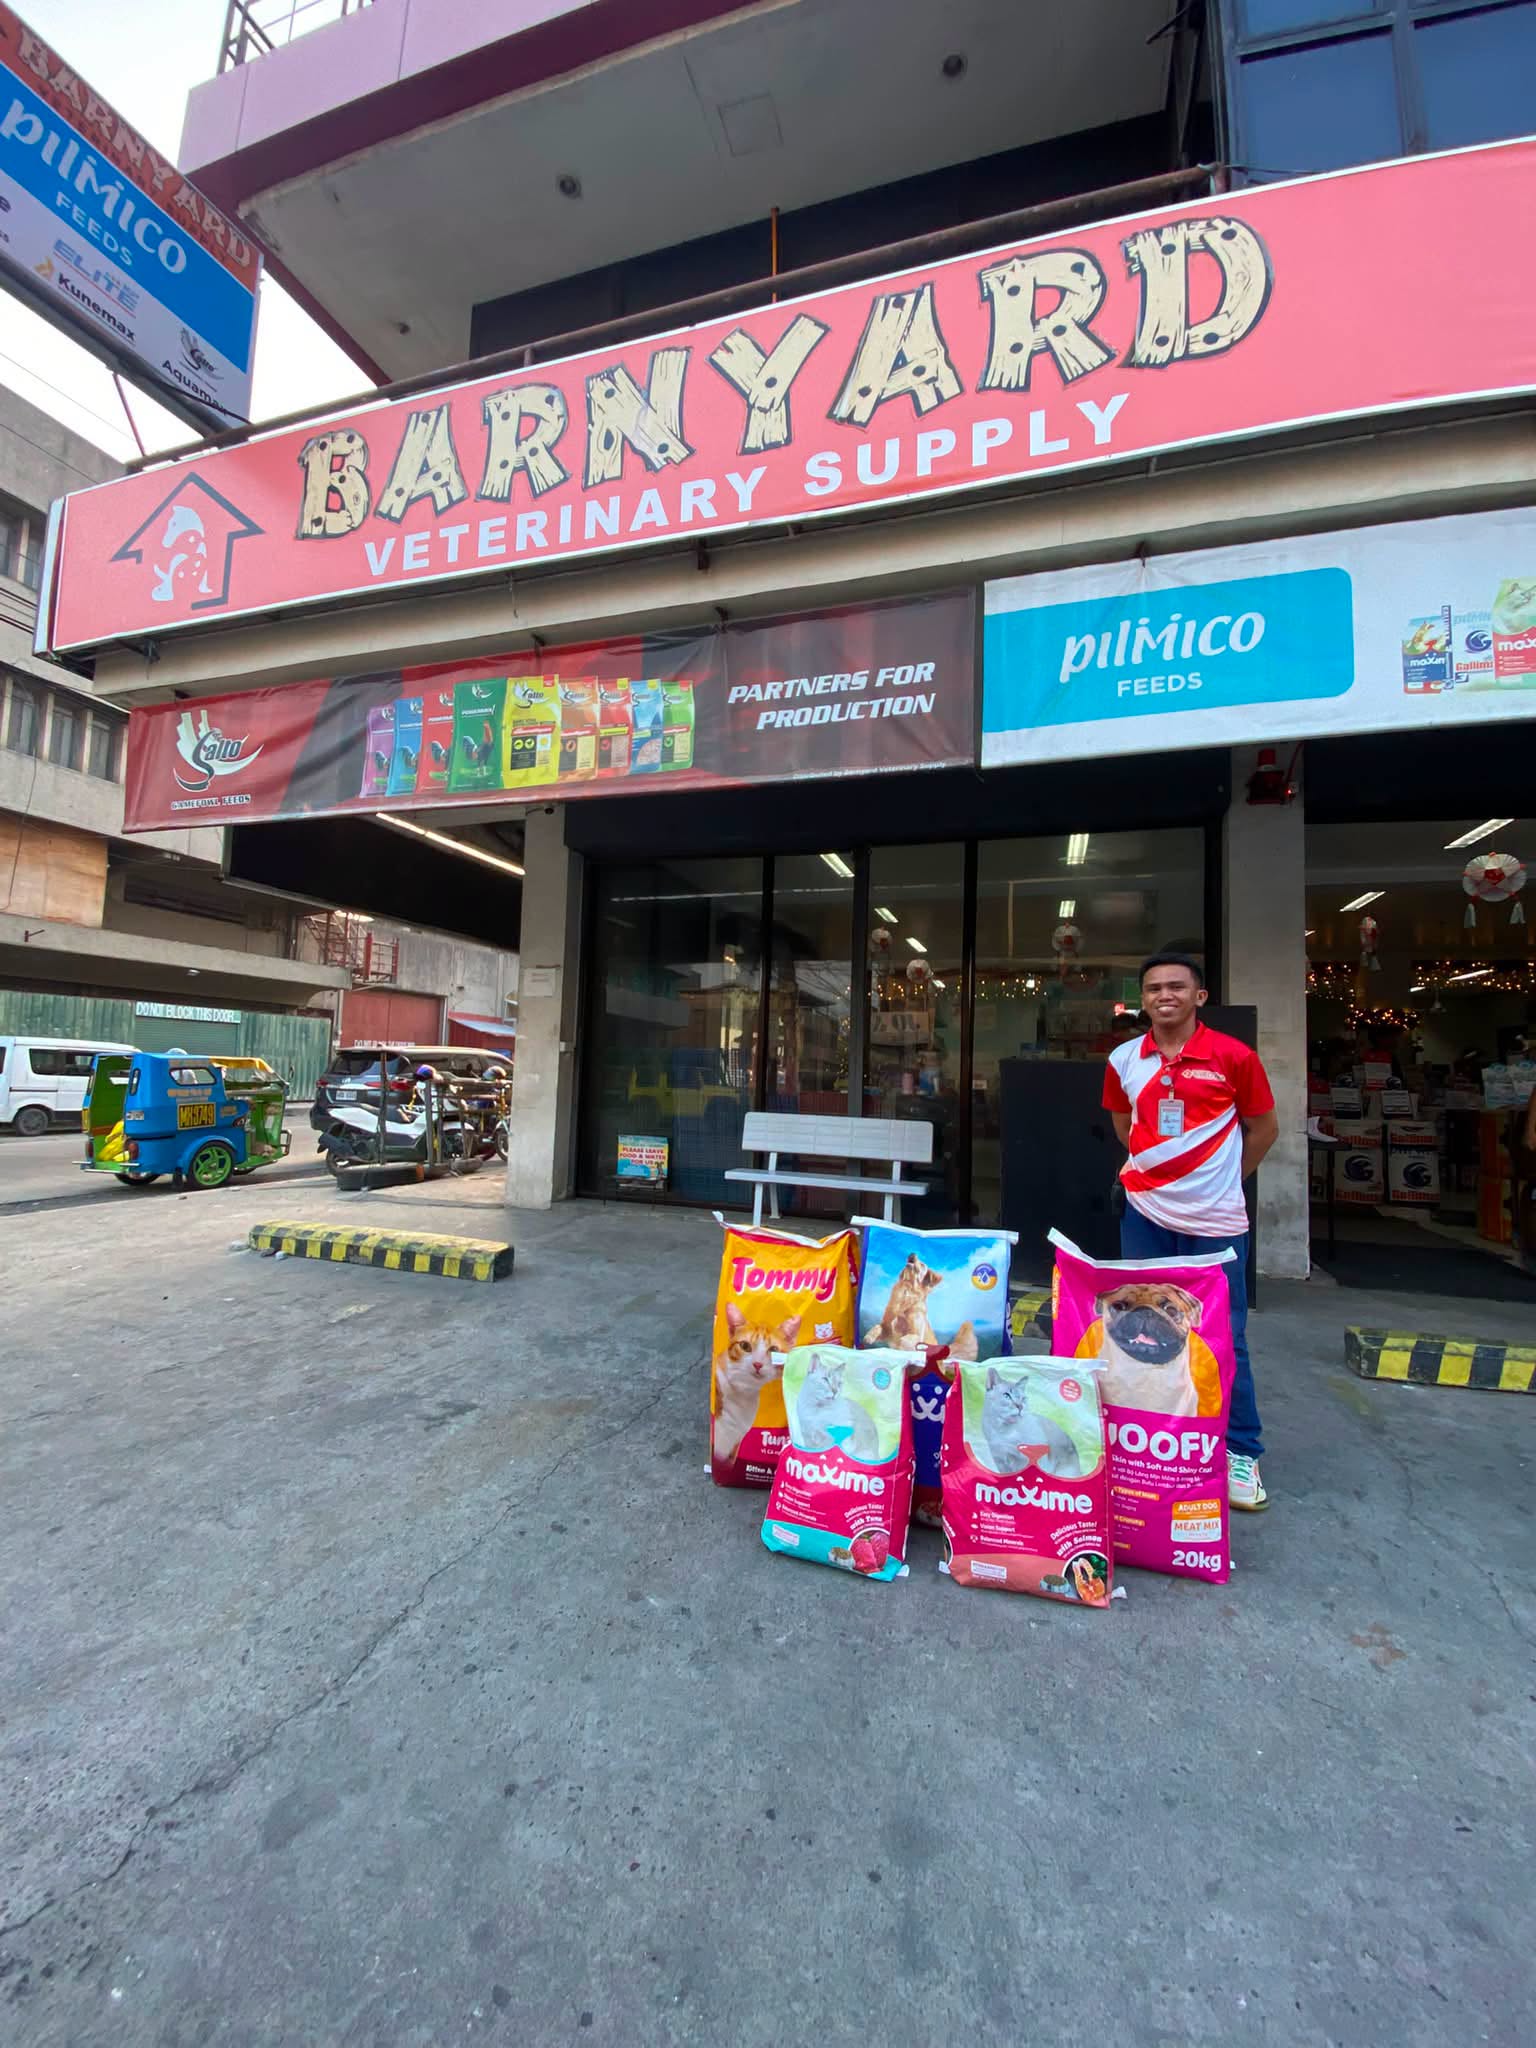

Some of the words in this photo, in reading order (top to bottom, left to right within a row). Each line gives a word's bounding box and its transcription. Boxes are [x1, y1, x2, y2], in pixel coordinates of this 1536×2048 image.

[18, 27, 252, 268] BARNYARD
[56, 191, 134, 267] FEEDS
[58, 271, 136, 342] Kunemax
[296, 215, 1274, 540] BARNYARD
[364, 466, 767, 576] VETERINARY
[804, 393, 1130, 496] SUPPLY
[728, 670, 870, 704] PARTNERS
[875, 662, 936, 688] FOR
[1117, 672, 1203, 697] FEEDS
[756, 693, 936, 730] PRODUCTION
[732, 1256, 837, 1303] Tommy
[786, 1455, 885, 1496] maxime
[1128, 1459, 1146, 1468] with
[1146, 1462, 1162, 1471] Soft
[1163, 1465, 1178, 1473] and
[1178, 1465, 1198, 1475] Shiny
[975, 1478, 1093, 1514] maxime
[1178, 1503, 1201, 1512] ADULT
[1202, 1502, 1218, 1510] DOG
[1050, 1523, 1077, 1541] Delicious
[1174, 1521, 1201, 1532] MEAT
[1203, 1521, 1220, 1530] MIX
[1171, 1549, 1221, 1572] 20kg
